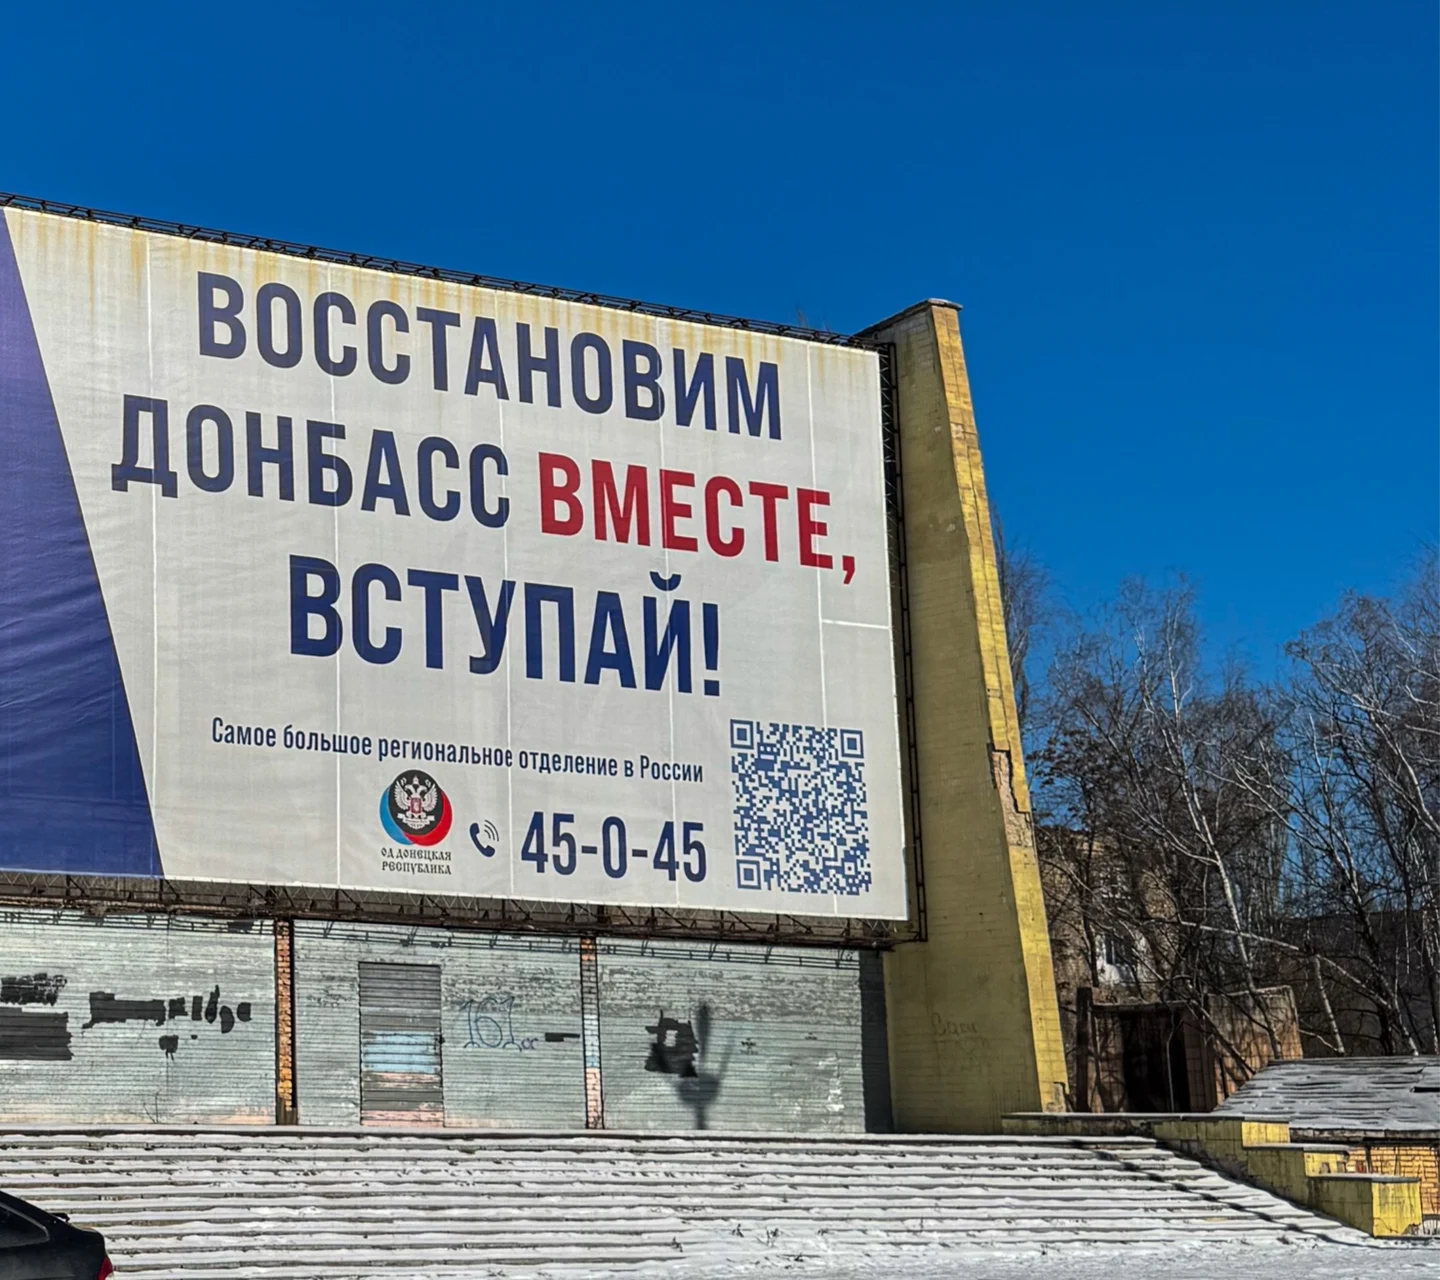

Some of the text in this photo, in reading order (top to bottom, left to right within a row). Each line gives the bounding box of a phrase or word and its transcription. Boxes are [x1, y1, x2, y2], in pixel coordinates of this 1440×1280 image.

[197, 271, 782, 441] ВОССТАНОВИМ
[111, 394, 856, 585] ДОНБАСС ВМЕСТЕ,
[289, 554, 721, 697] ВСТУПАЙ!
[212, 717, 703, 783] Самое большое региональное отделение в России
[381, 861, 453, 876] РЕСПУБЛИКА
[396, 848, 452, 862] ДОНЕЦКАЯ
[520, 811, 707, 883] 45-0-45
